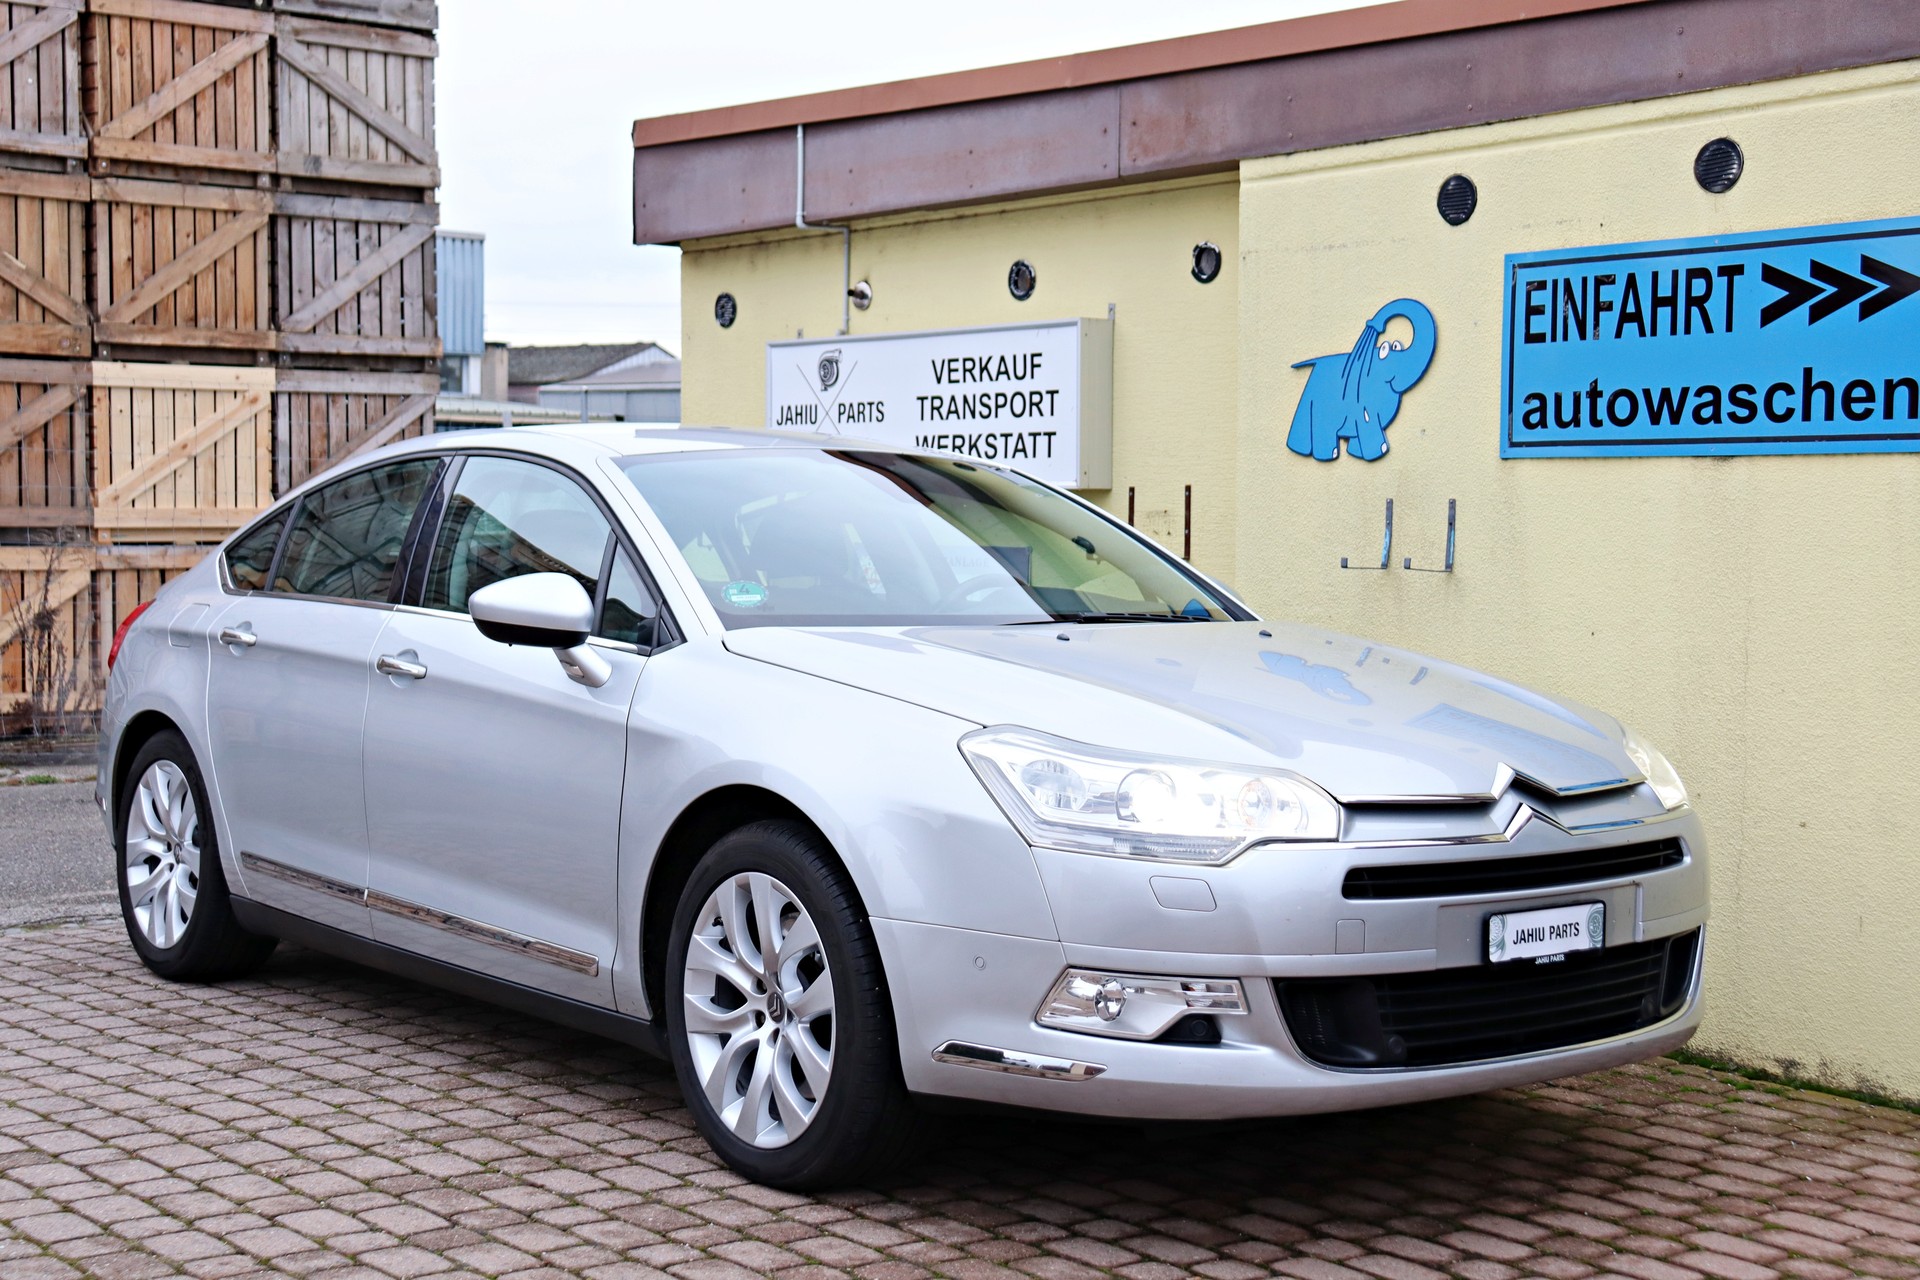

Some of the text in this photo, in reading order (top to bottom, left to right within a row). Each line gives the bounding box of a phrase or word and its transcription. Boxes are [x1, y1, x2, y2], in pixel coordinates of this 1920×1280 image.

[1523, 263, 1745, 345] EINFAHRT
[931, 352, 1043, 385] VERKAUF
[776, 400, 885, 426] JAHIU PARTS
[916, 389, 1060, 421] TRANSPORT
[1521, 366, 1919, 430] autowaschen
[1512, 921, 1580, 945] JAHIU PARTS
[1535, 953, 1565, 965] JAHIU PARTS
